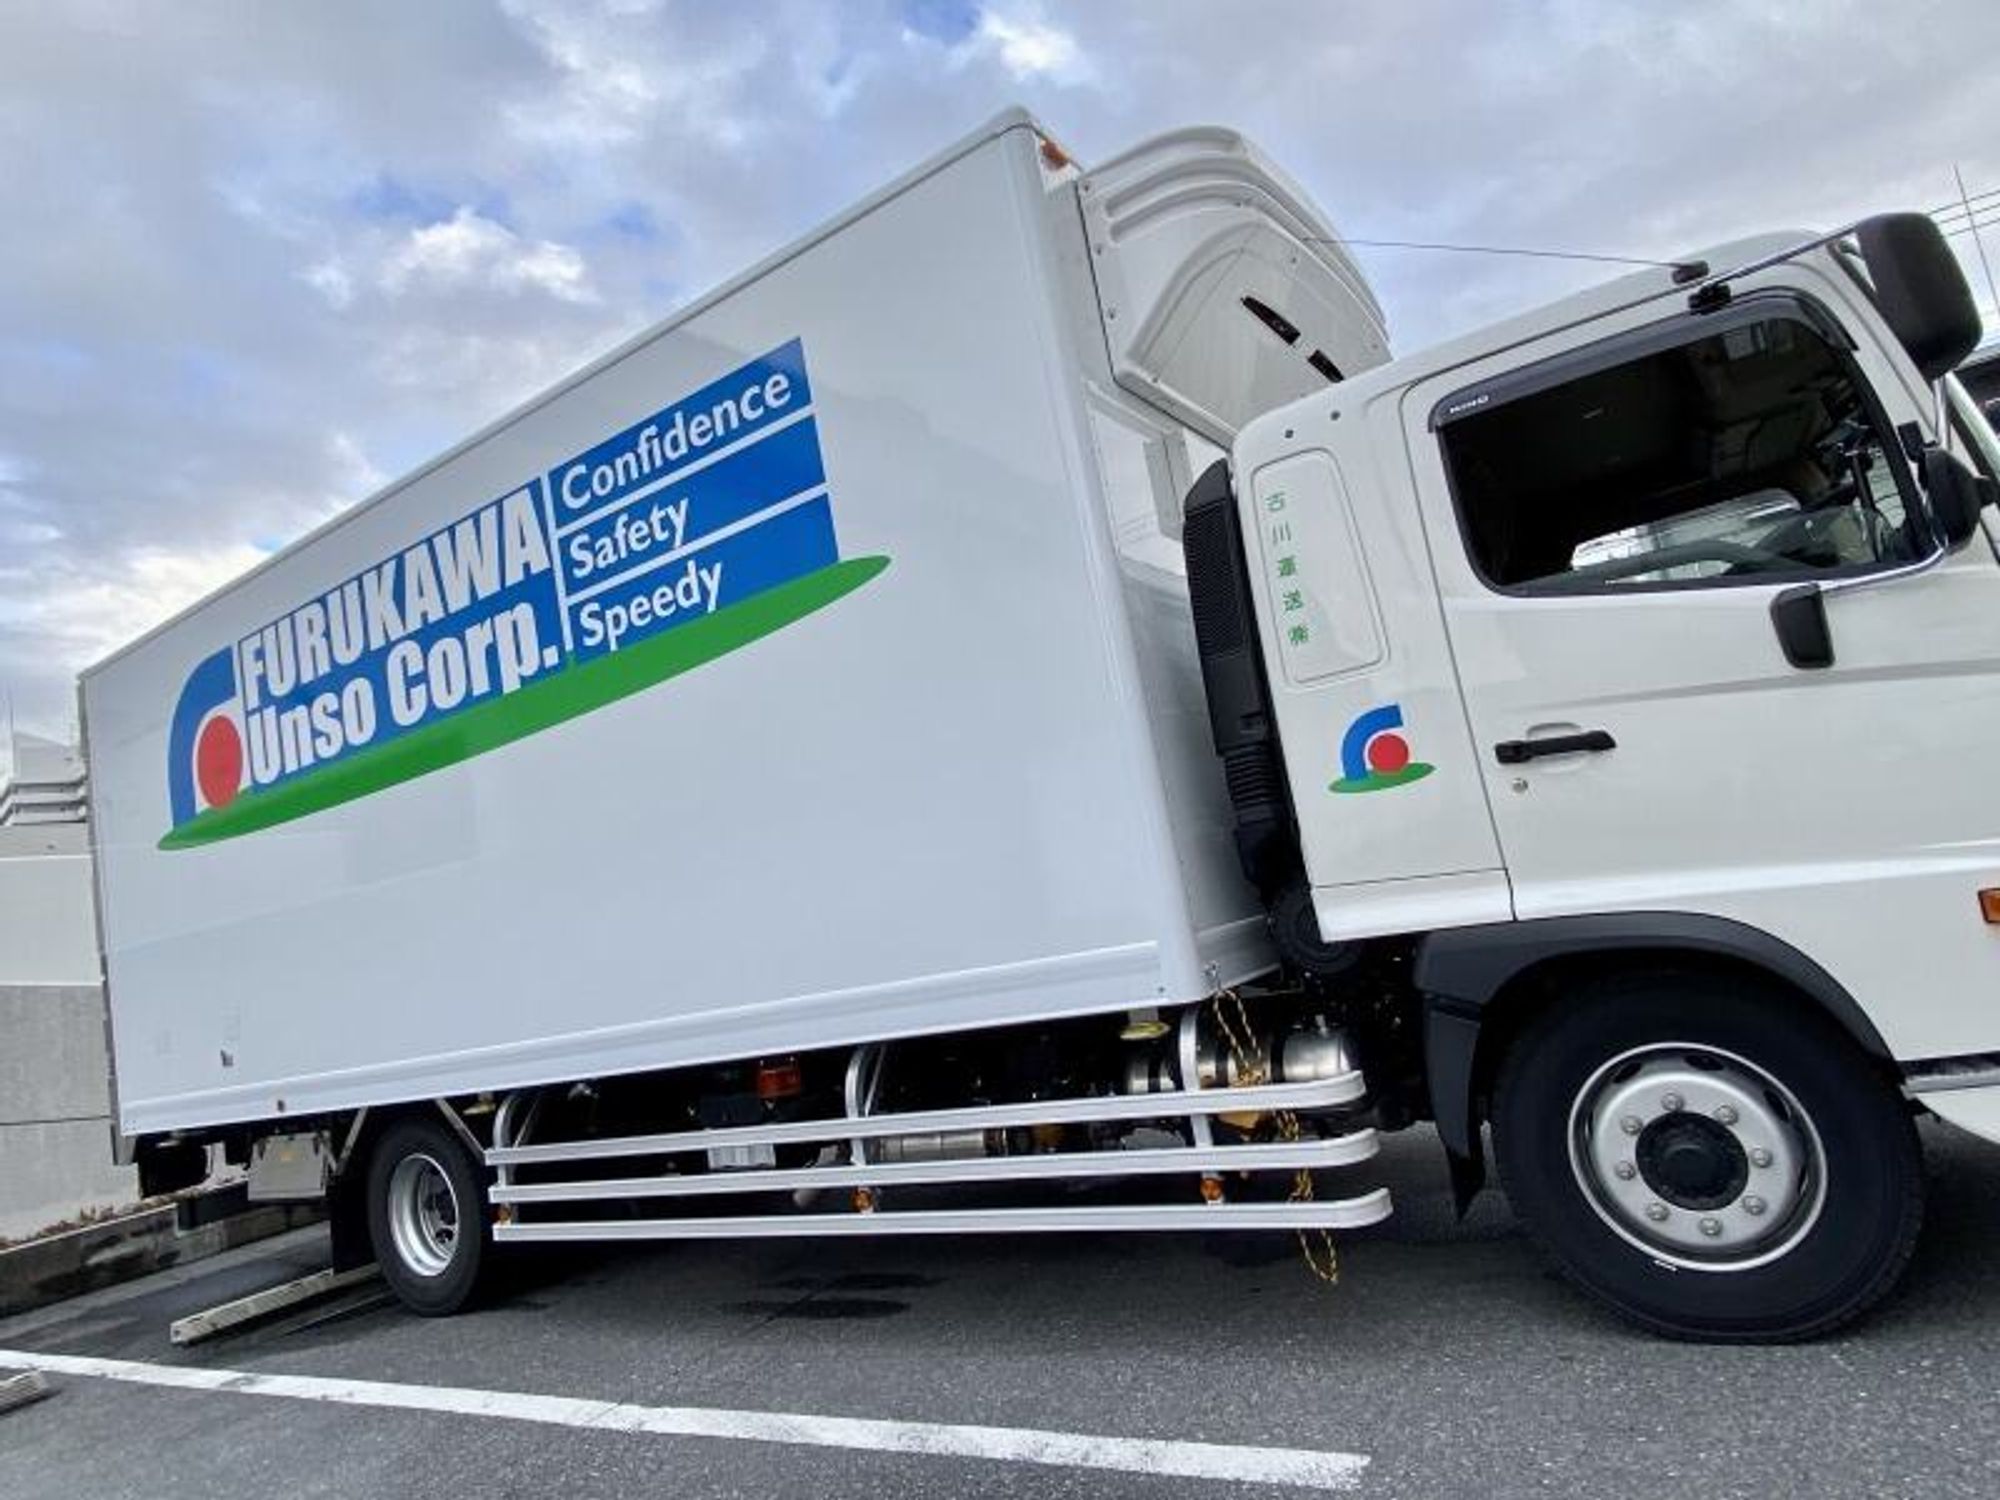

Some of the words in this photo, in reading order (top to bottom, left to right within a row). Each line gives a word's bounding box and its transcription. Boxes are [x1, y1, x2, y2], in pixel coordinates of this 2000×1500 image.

[562, 373, 791, 509] Confidence
[240, 488, 550, 711] FURUKAWA
[569, 498, 688, 578] Safety
[579, 560, 722, 652] Speedy
[248, 676, 376, 783] Unso
[386, 602, 559, 727] Corp.
